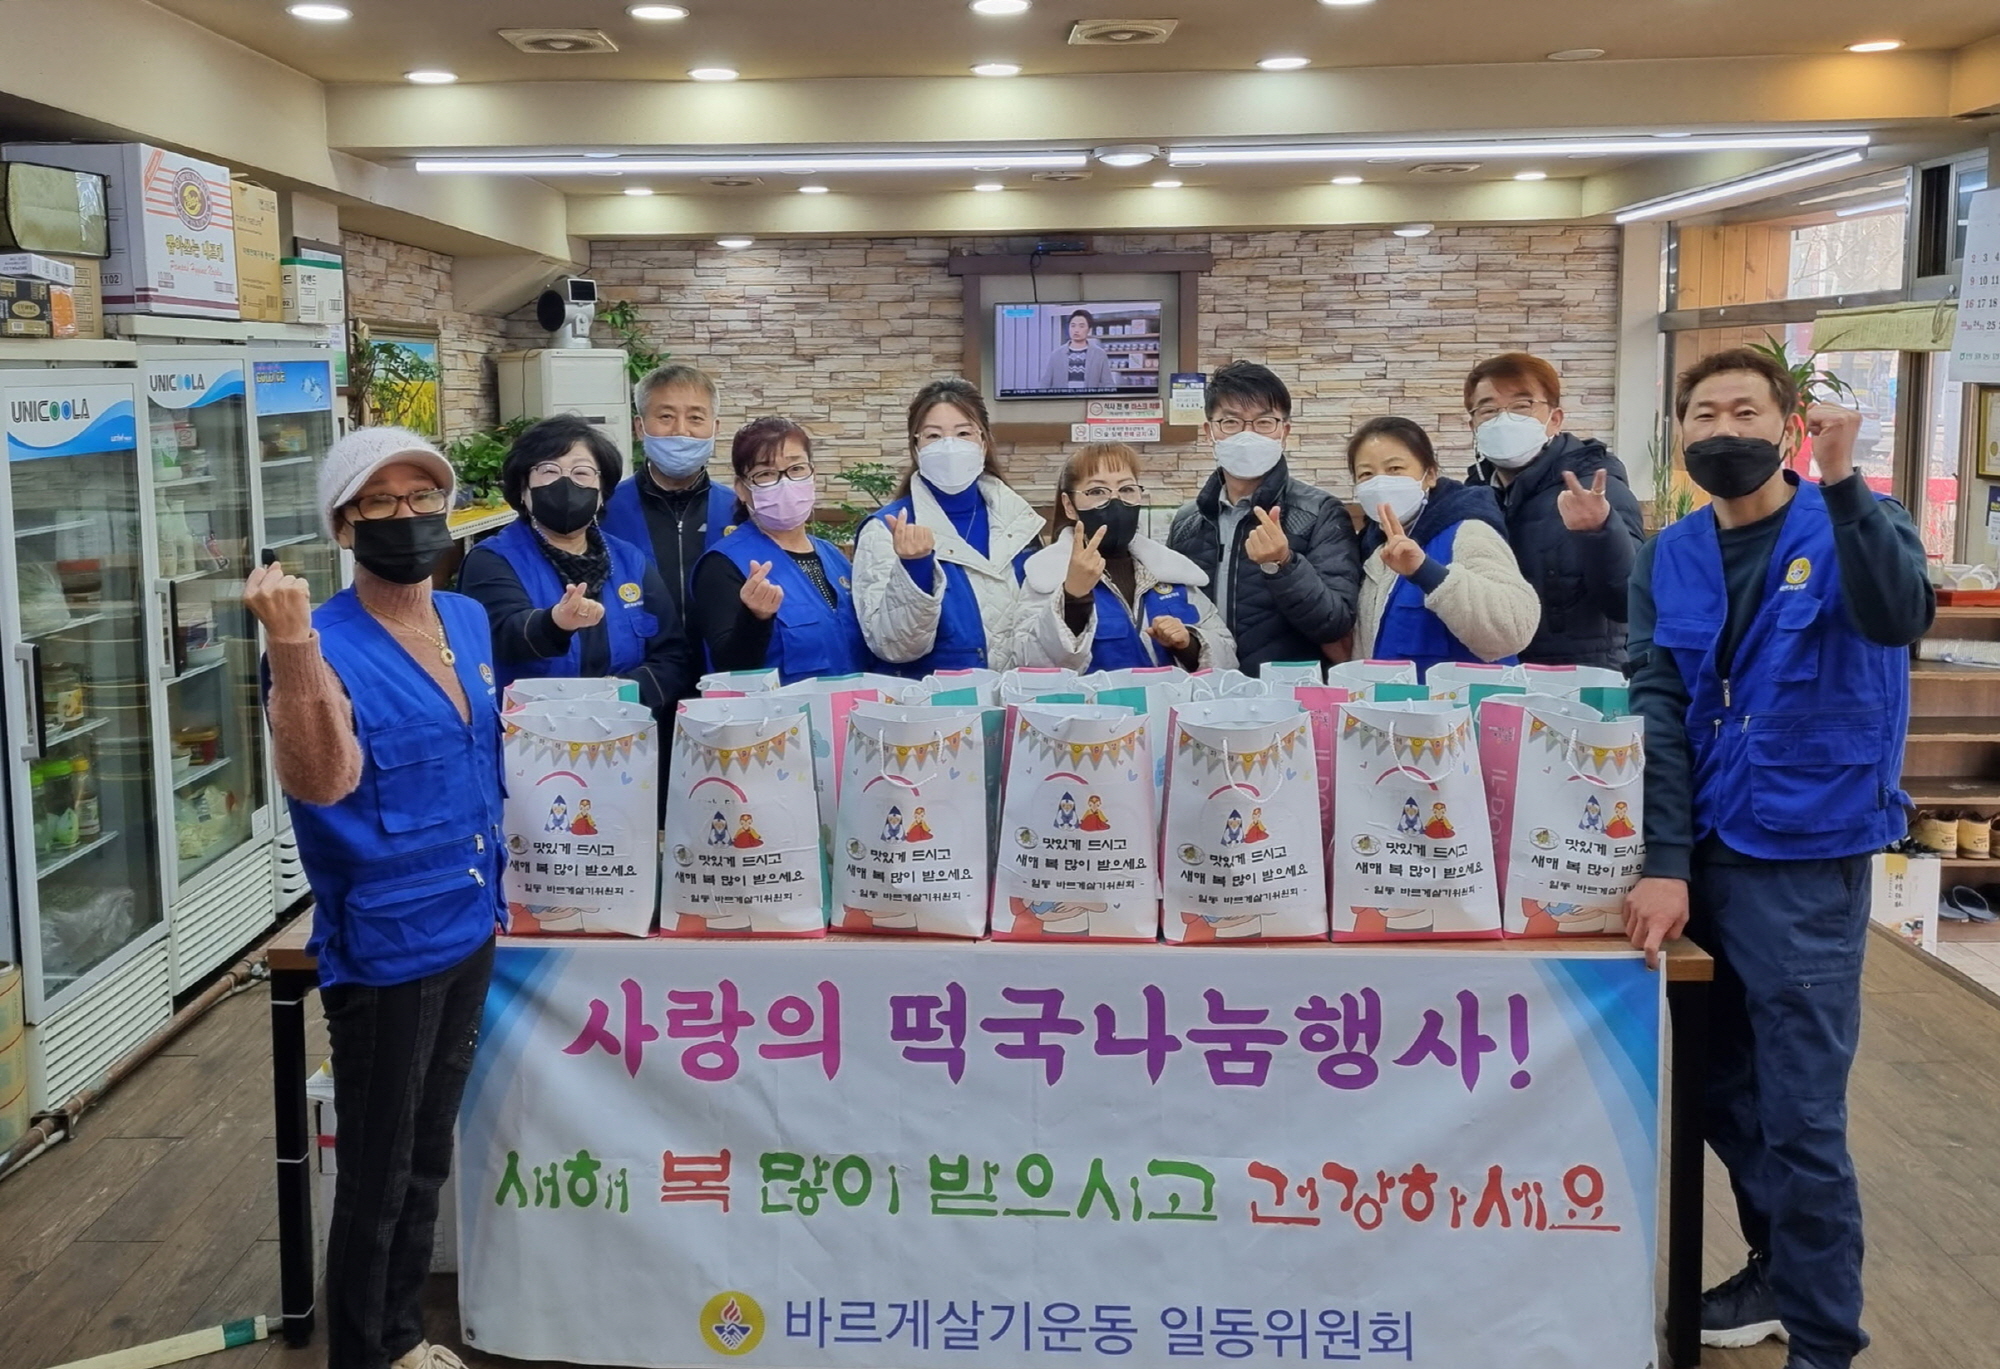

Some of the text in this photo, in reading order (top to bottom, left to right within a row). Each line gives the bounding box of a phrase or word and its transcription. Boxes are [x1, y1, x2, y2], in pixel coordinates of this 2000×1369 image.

[149, 372, 206, 392] UNICOOLA
[11, 398, 91, 423] UNICOOLA
[533, 842, 614, 856] 맛있게 드시고
[1042, 837, 1127, 851] 맛있게 드시고
[1386, 842, 1467, 858] 맛있게 드시고
[1565, 838, 1606, 856] 맛있게
[699, 853, 782, 867] 맛있게 드시고
[870, 848, 951, 864] 맛있게 드시고
[1065, 859, 1090, 871] 많이
[1097, 857, 1147, 871] 받으세요
[1210, 846, 1287, 868] 맛있게 드시고
[554, 864, 578, 876] 많이
[585, 865, 637, 876] 받으세요
[721, 875, 746, 886] 많이
[753, 870, 804, 885] 받으세요
[891, 871, 915, 883] 많이
[922, 868, 973, 882] 받으세요
[1232, 873, 1256, 887] 많이
[1262, 863, 1308, 882] 받으세요
[1409, 865, 1436, 879] 많이
[1444, 861, 1483, 879] 받으세요
[1587, 863, 1614, 878] 많이
[1621, 863, 1643, 876] 받으
[562, 977, 1532, 1093] 사랑의 떡국나눔행사!
[495, 1148, 1622, 1231] 새해 복 많이 받으시고 건강하세요
[785, 1297, 1414, 1361] 바르게살기운동 일동위원회
